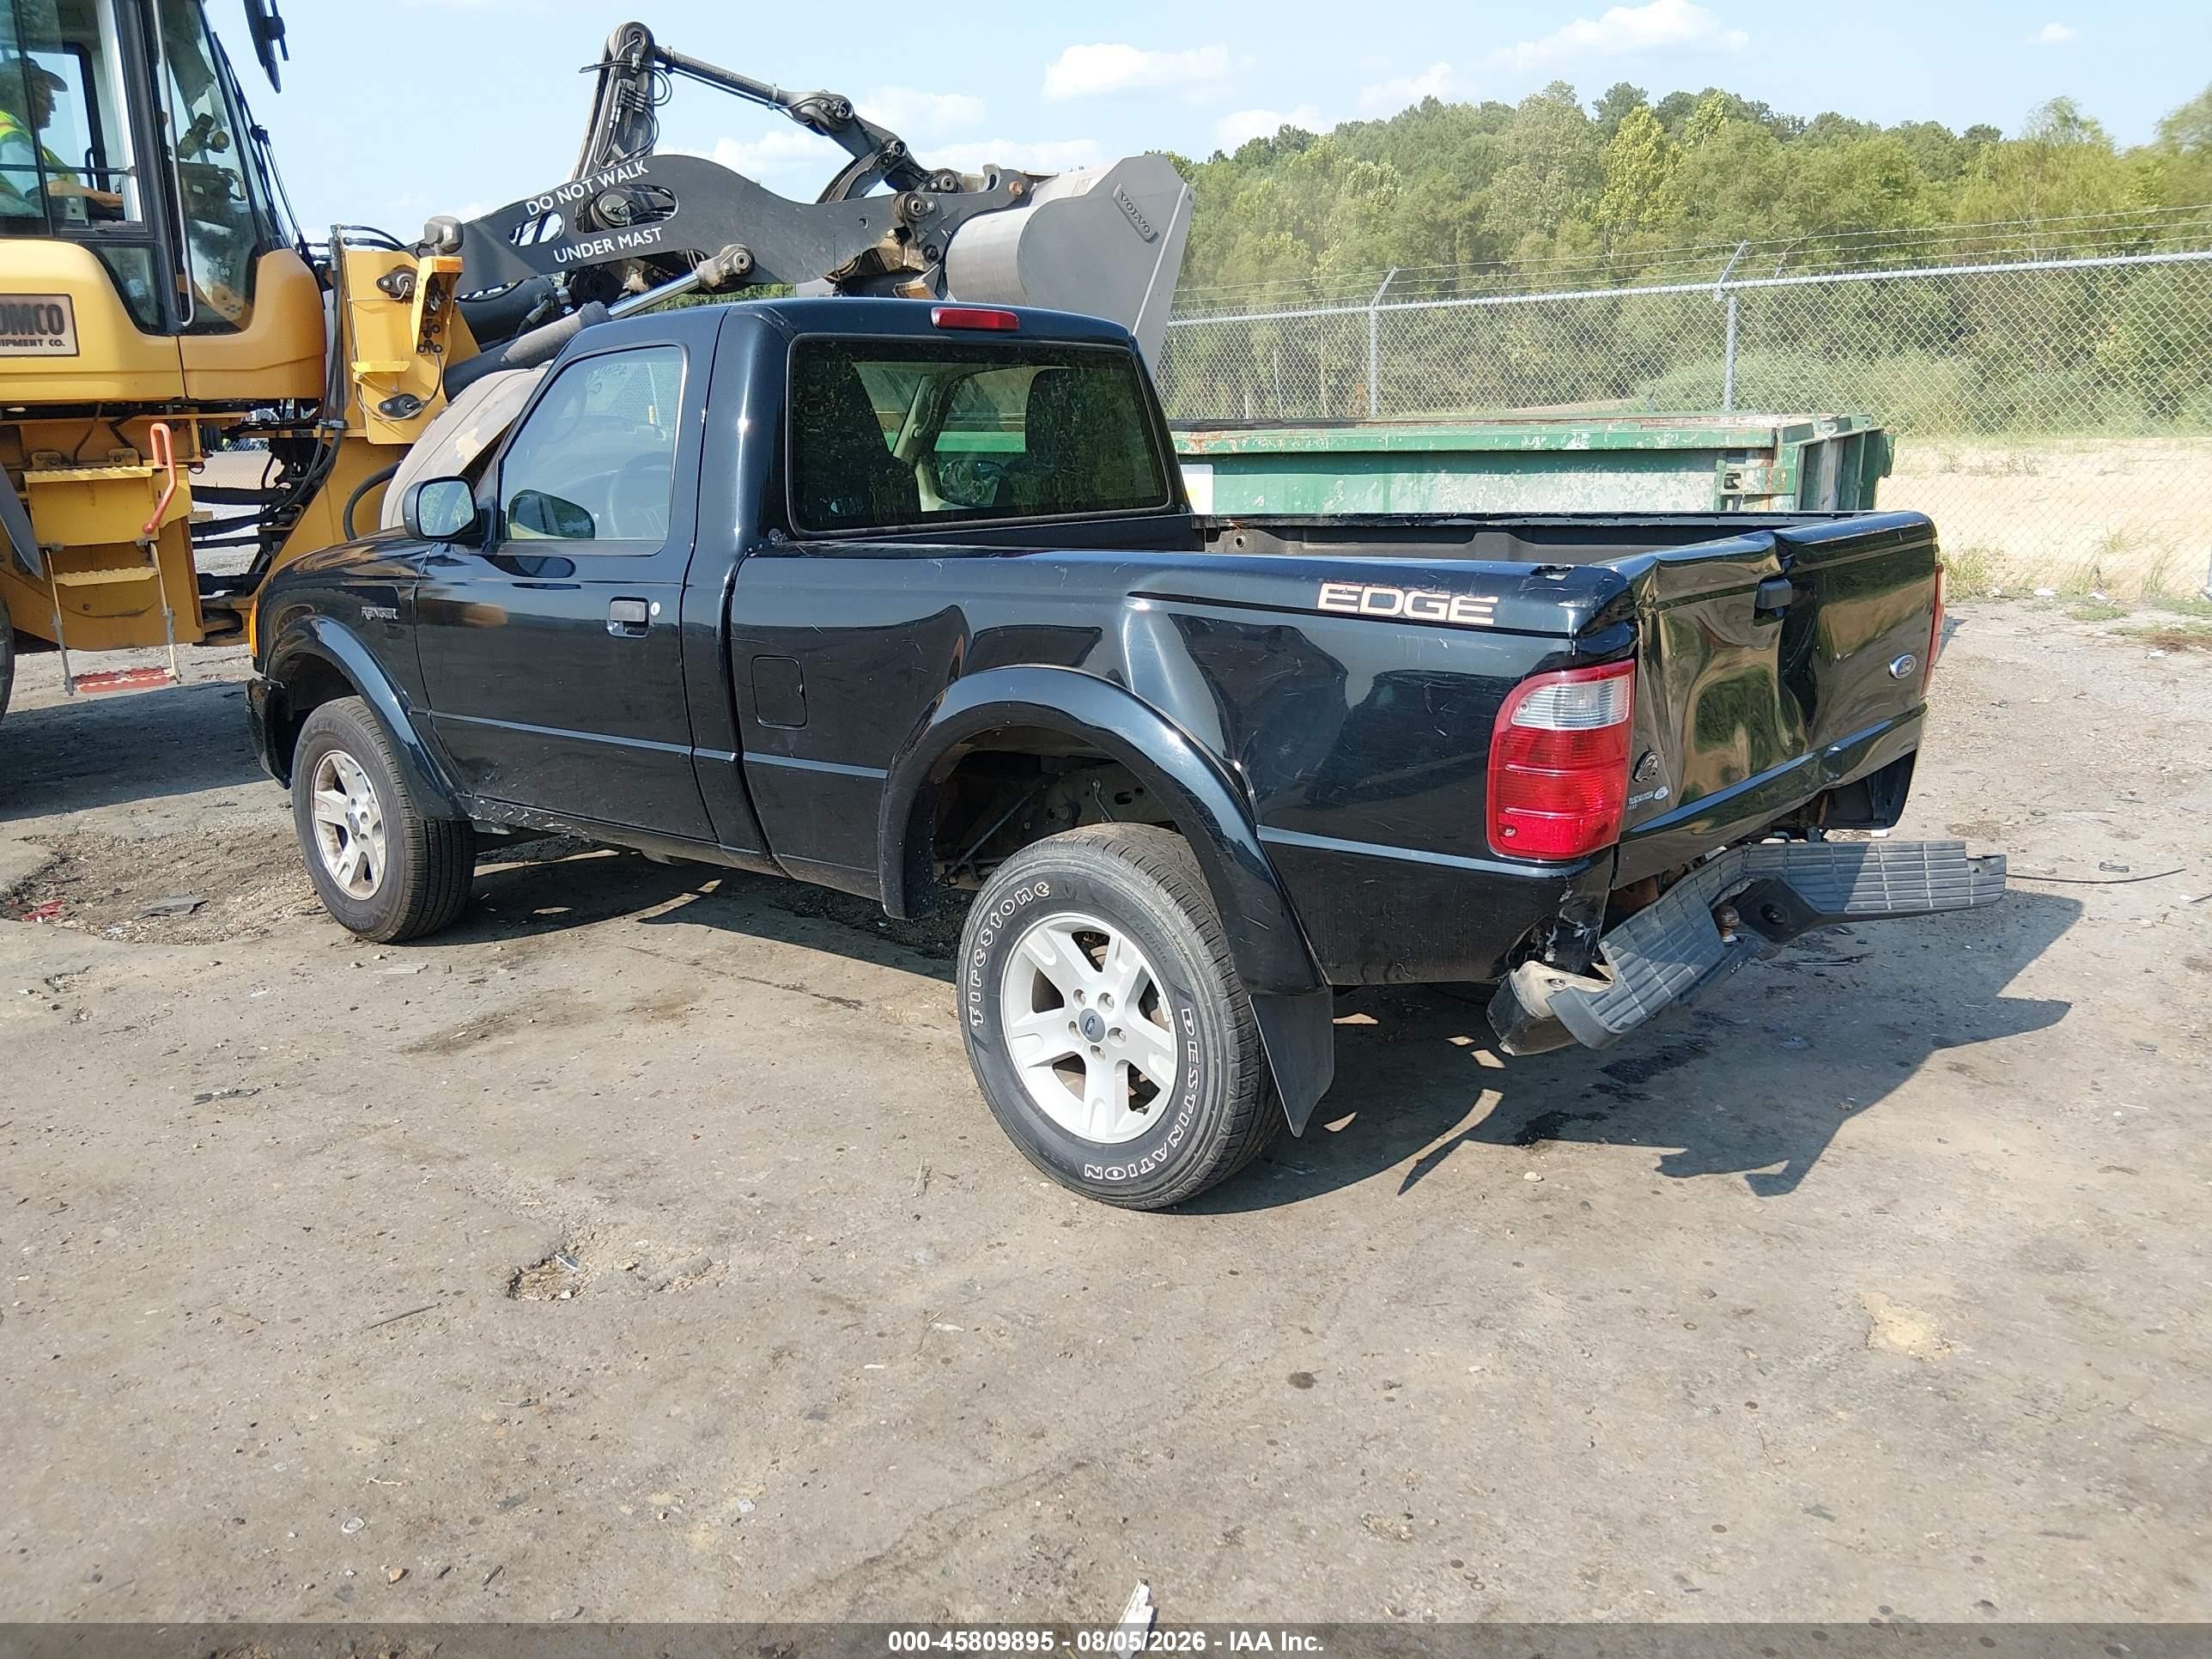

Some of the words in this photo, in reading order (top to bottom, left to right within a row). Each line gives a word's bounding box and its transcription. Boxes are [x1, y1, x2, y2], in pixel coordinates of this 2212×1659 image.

[526, 196, 554, 216] DO
[556, 179, 593, 205] NOT
[597, 160, 649, 188] WALK
[1120, 191, 1151, 234] VOLVO
[553, 240, 616, 264] UNDER
[617, 227, 662, 250] MAST
[0, 338, 44, 347] IPMENT
[49, 338, 65, 347] CO.
[1317, 582, 1498, 625] EDGE
[969, 881, 1050, 1027] Firestone
[1085, 1008, 1199, 1180] DESTINATION
